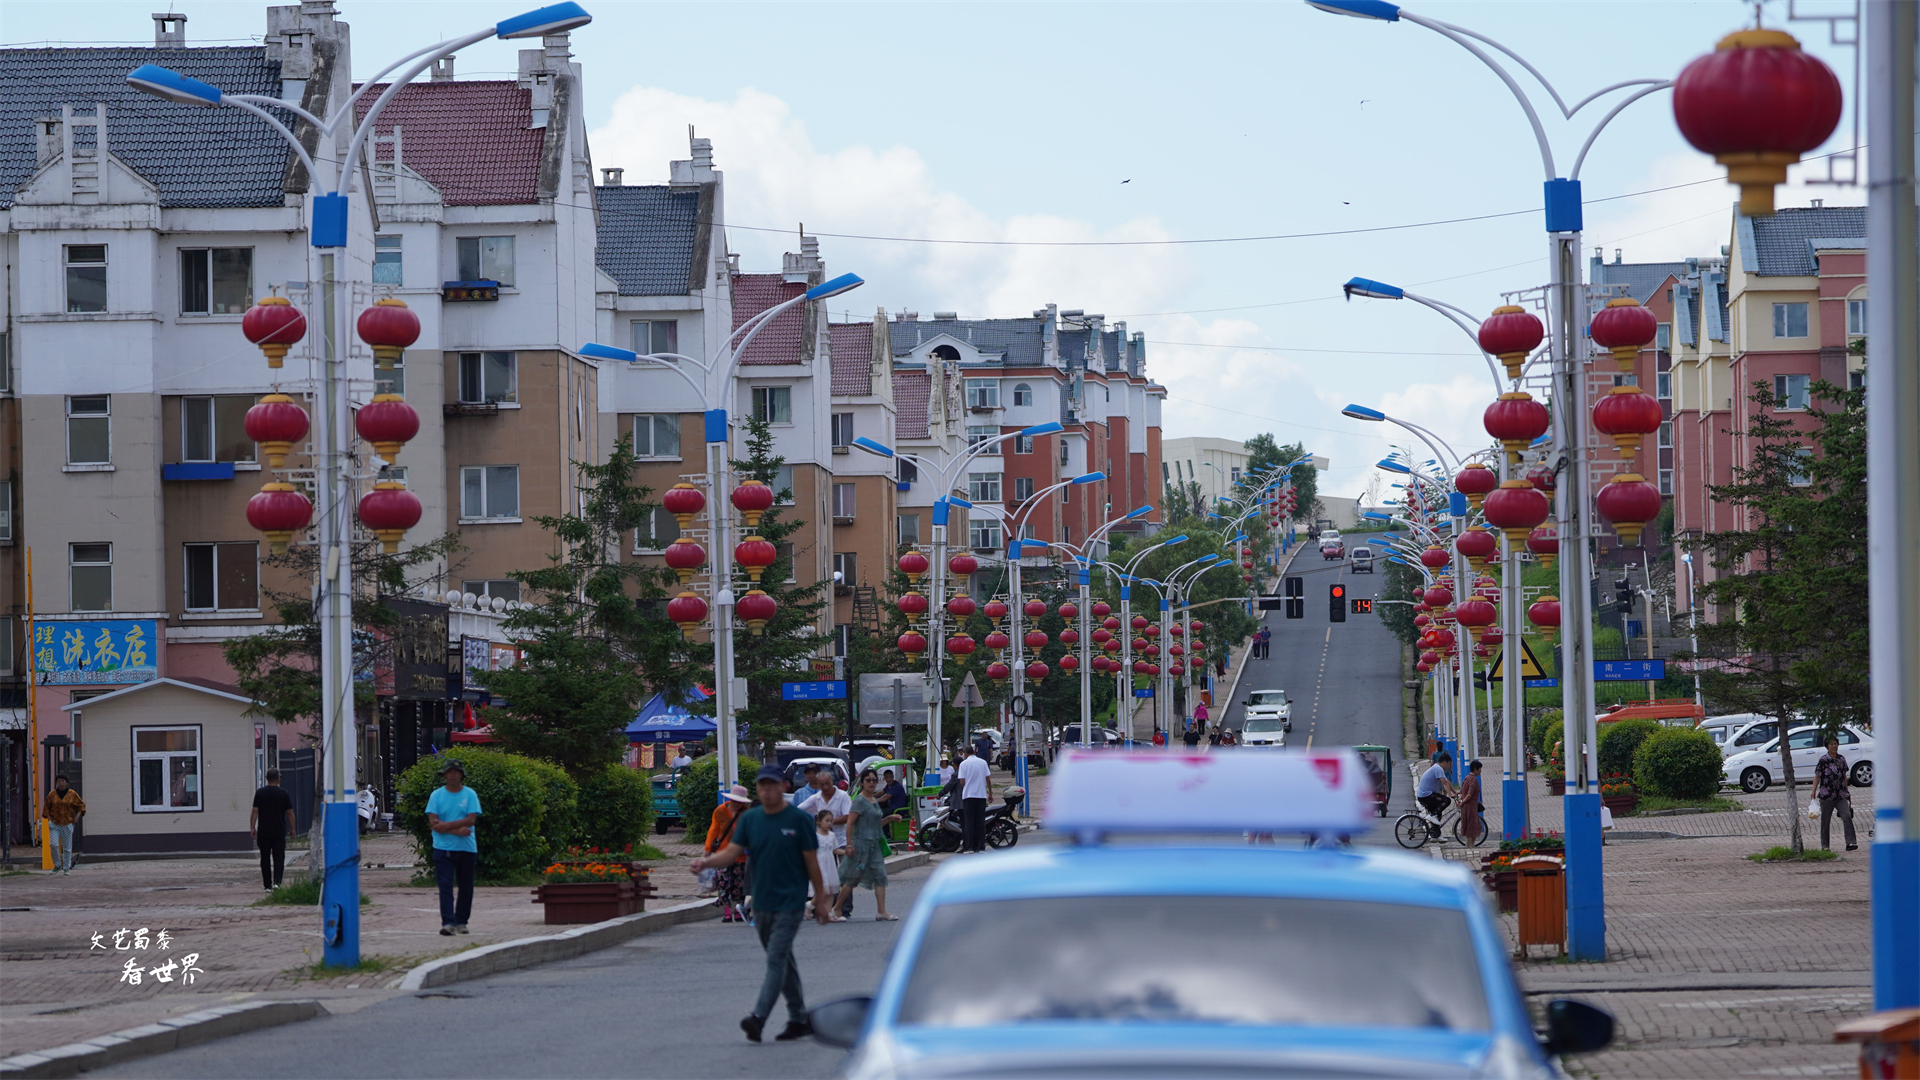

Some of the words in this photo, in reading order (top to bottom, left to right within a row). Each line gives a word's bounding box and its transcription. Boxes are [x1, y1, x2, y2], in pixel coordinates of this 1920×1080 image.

[1358, 600, 1370, 612] 14
[36, 626, 57, 669] 理想
[61, 625, 147, 669] 洗衣店
[1605, 662, 1651, 672] 南二街
[793, 683, 834, 692] 南二街
